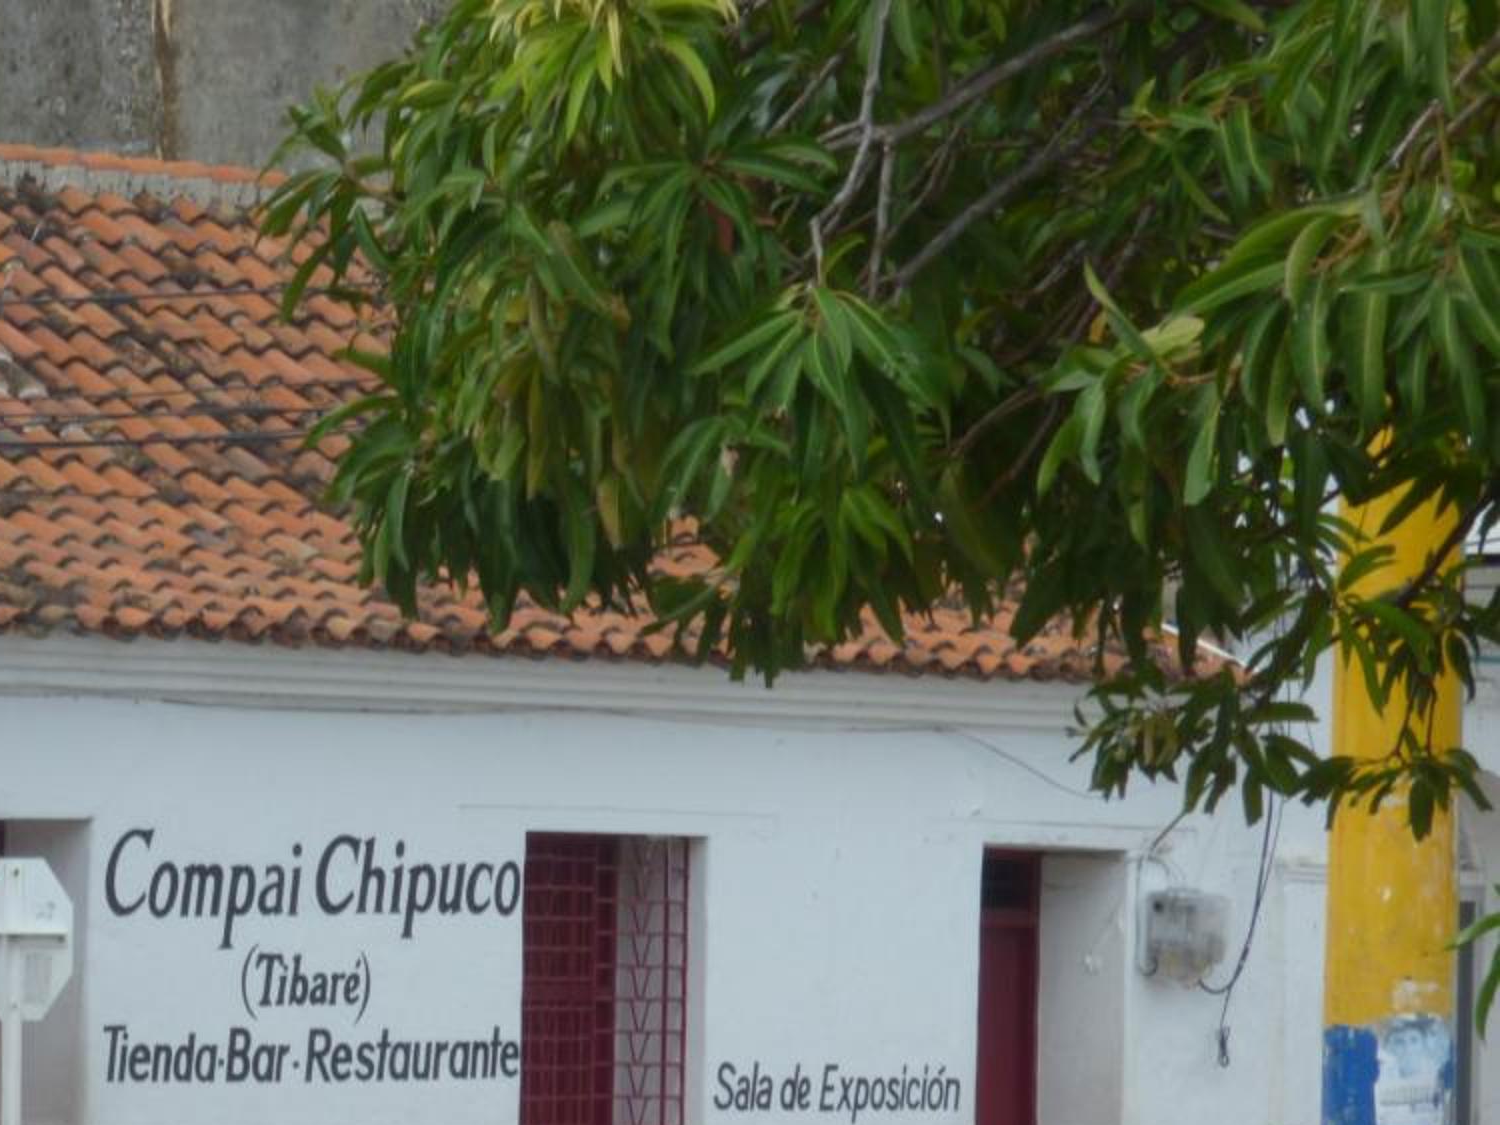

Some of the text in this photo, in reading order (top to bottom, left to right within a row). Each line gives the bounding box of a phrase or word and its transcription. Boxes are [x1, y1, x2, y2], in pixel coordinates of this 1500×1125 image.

[104, 827, 521, 950] Compai Chipuco
[712, 1060, 961, 1125] Sala de Exposición
